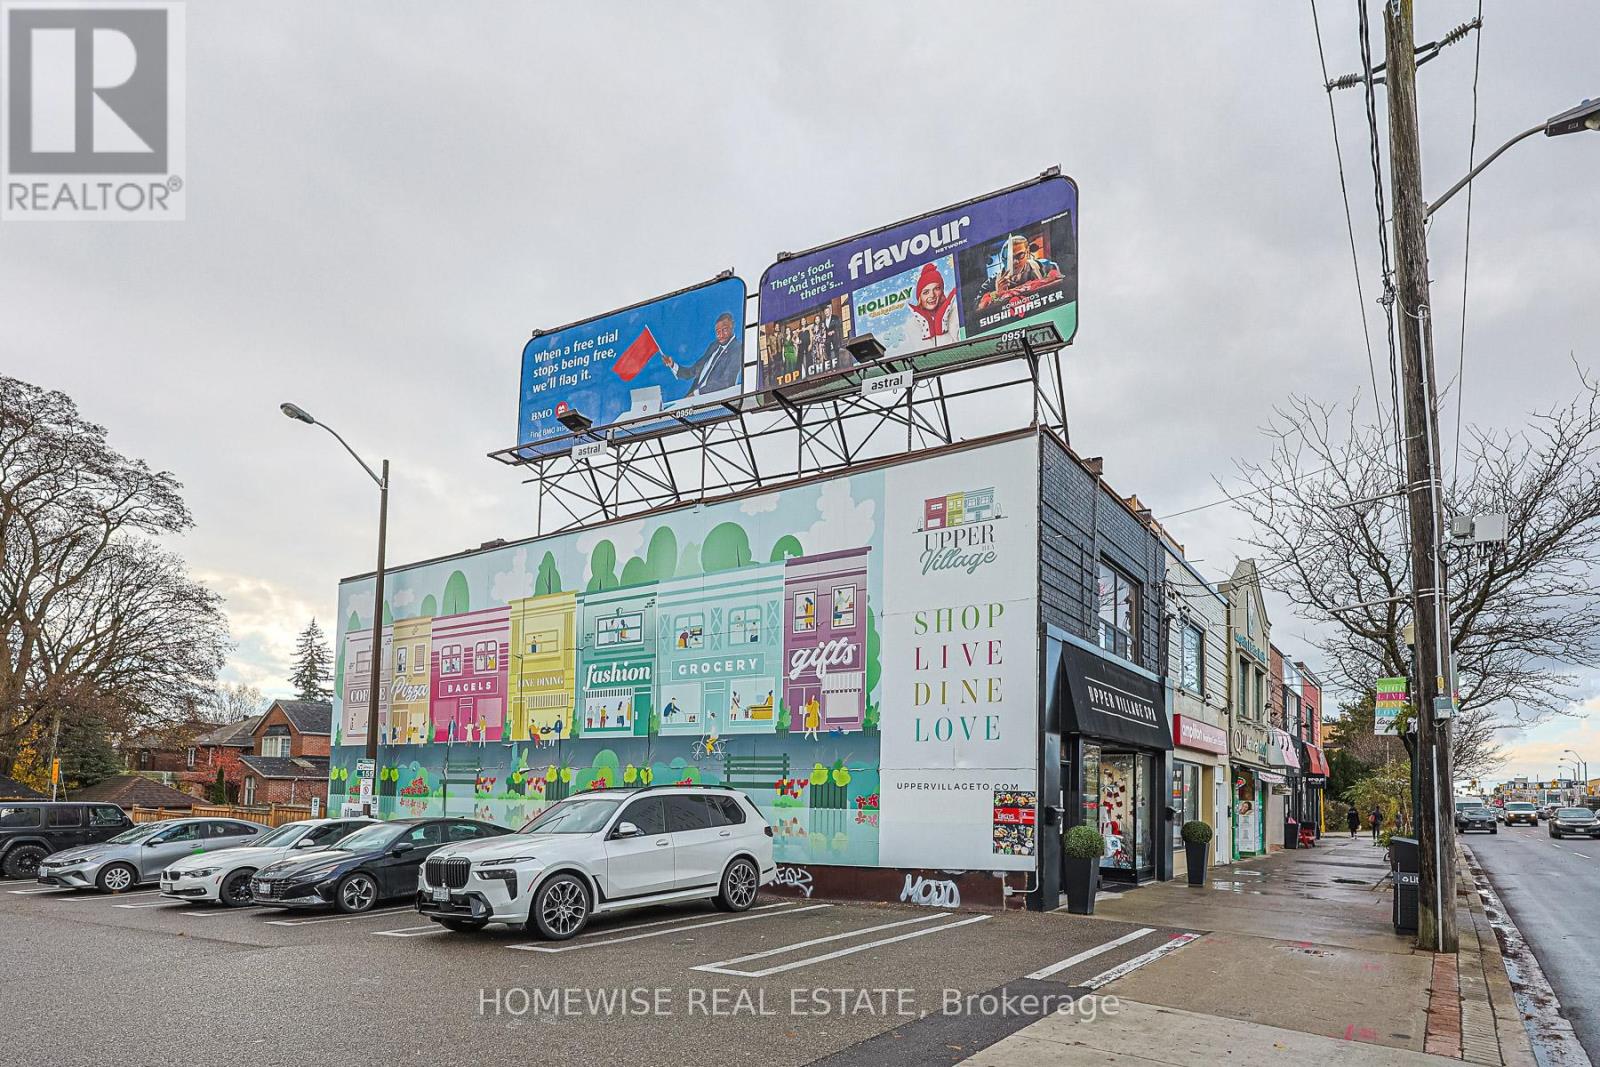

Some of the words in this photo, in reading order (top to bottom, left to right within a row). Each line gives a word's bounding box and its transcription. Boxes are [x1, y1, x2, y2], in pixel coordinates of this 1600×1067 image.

[848, 216, 971, 280] flavour
[936, 238, 968, 254] NETWORK
[770, 271, 806, 290] There's
[807, 259, 835, 277] food.
[788, 279, 809, 295] And
[810, 271, 834, 286] then
[800, 281, 844, 300] there's...
[857, 287, 913, 316] HOLIDAY
[1014, 290, 1065, 316] MASTER
[534, 349, 562, 364] When
[564, 346, 571, 355] a
[573, 340, 594, 353] free
[597, 329, 619, 346] trial
[1002, 329, 1026, 343] 0951
[533, 363, 559, 378] stops
[561, 355, 590, 370] being
[593, 348, 617, 362] free,
[776, 370, 800, 385] TOP
[808, 358, 838, 376] CHEF
[533, 376, 556, 393] we'll
[559, 374, 578, 386] flag
[581, 369, 592, 380] it.
[871, 375, 903, 391] astral
[531, 408, 553, 421] BMO
[578, 445, 601, 456] astral
[925, 524, 995, 551] UPPER
[920, 546, 997, 575] Village
[914, 603, 1005, 635] SHOP
[679, 658, 758, 675] GROCERY
[789, 637, 857, 680] gifts
[915, 640, 1003, 671] LIVE
[447, 681, 492, 693] BAGELS
[536, 676, 564, 687] DINING
[583, 661, 651, 690] fashion
[351, 687, 386, 703] COFE
[391, 676, 428, 702] Pizza
[913, 677, 1003, 706] DINE
[1088, 685, 1115, 709] UPPER
[1115, 695, 1144, 718] VILLAGE
[1144, 705, 1157, 721] SPA
[915, 715, 1001, 742] LOVE
[896, 782, 1019, 791] UPPERVILLAGETO.COM
